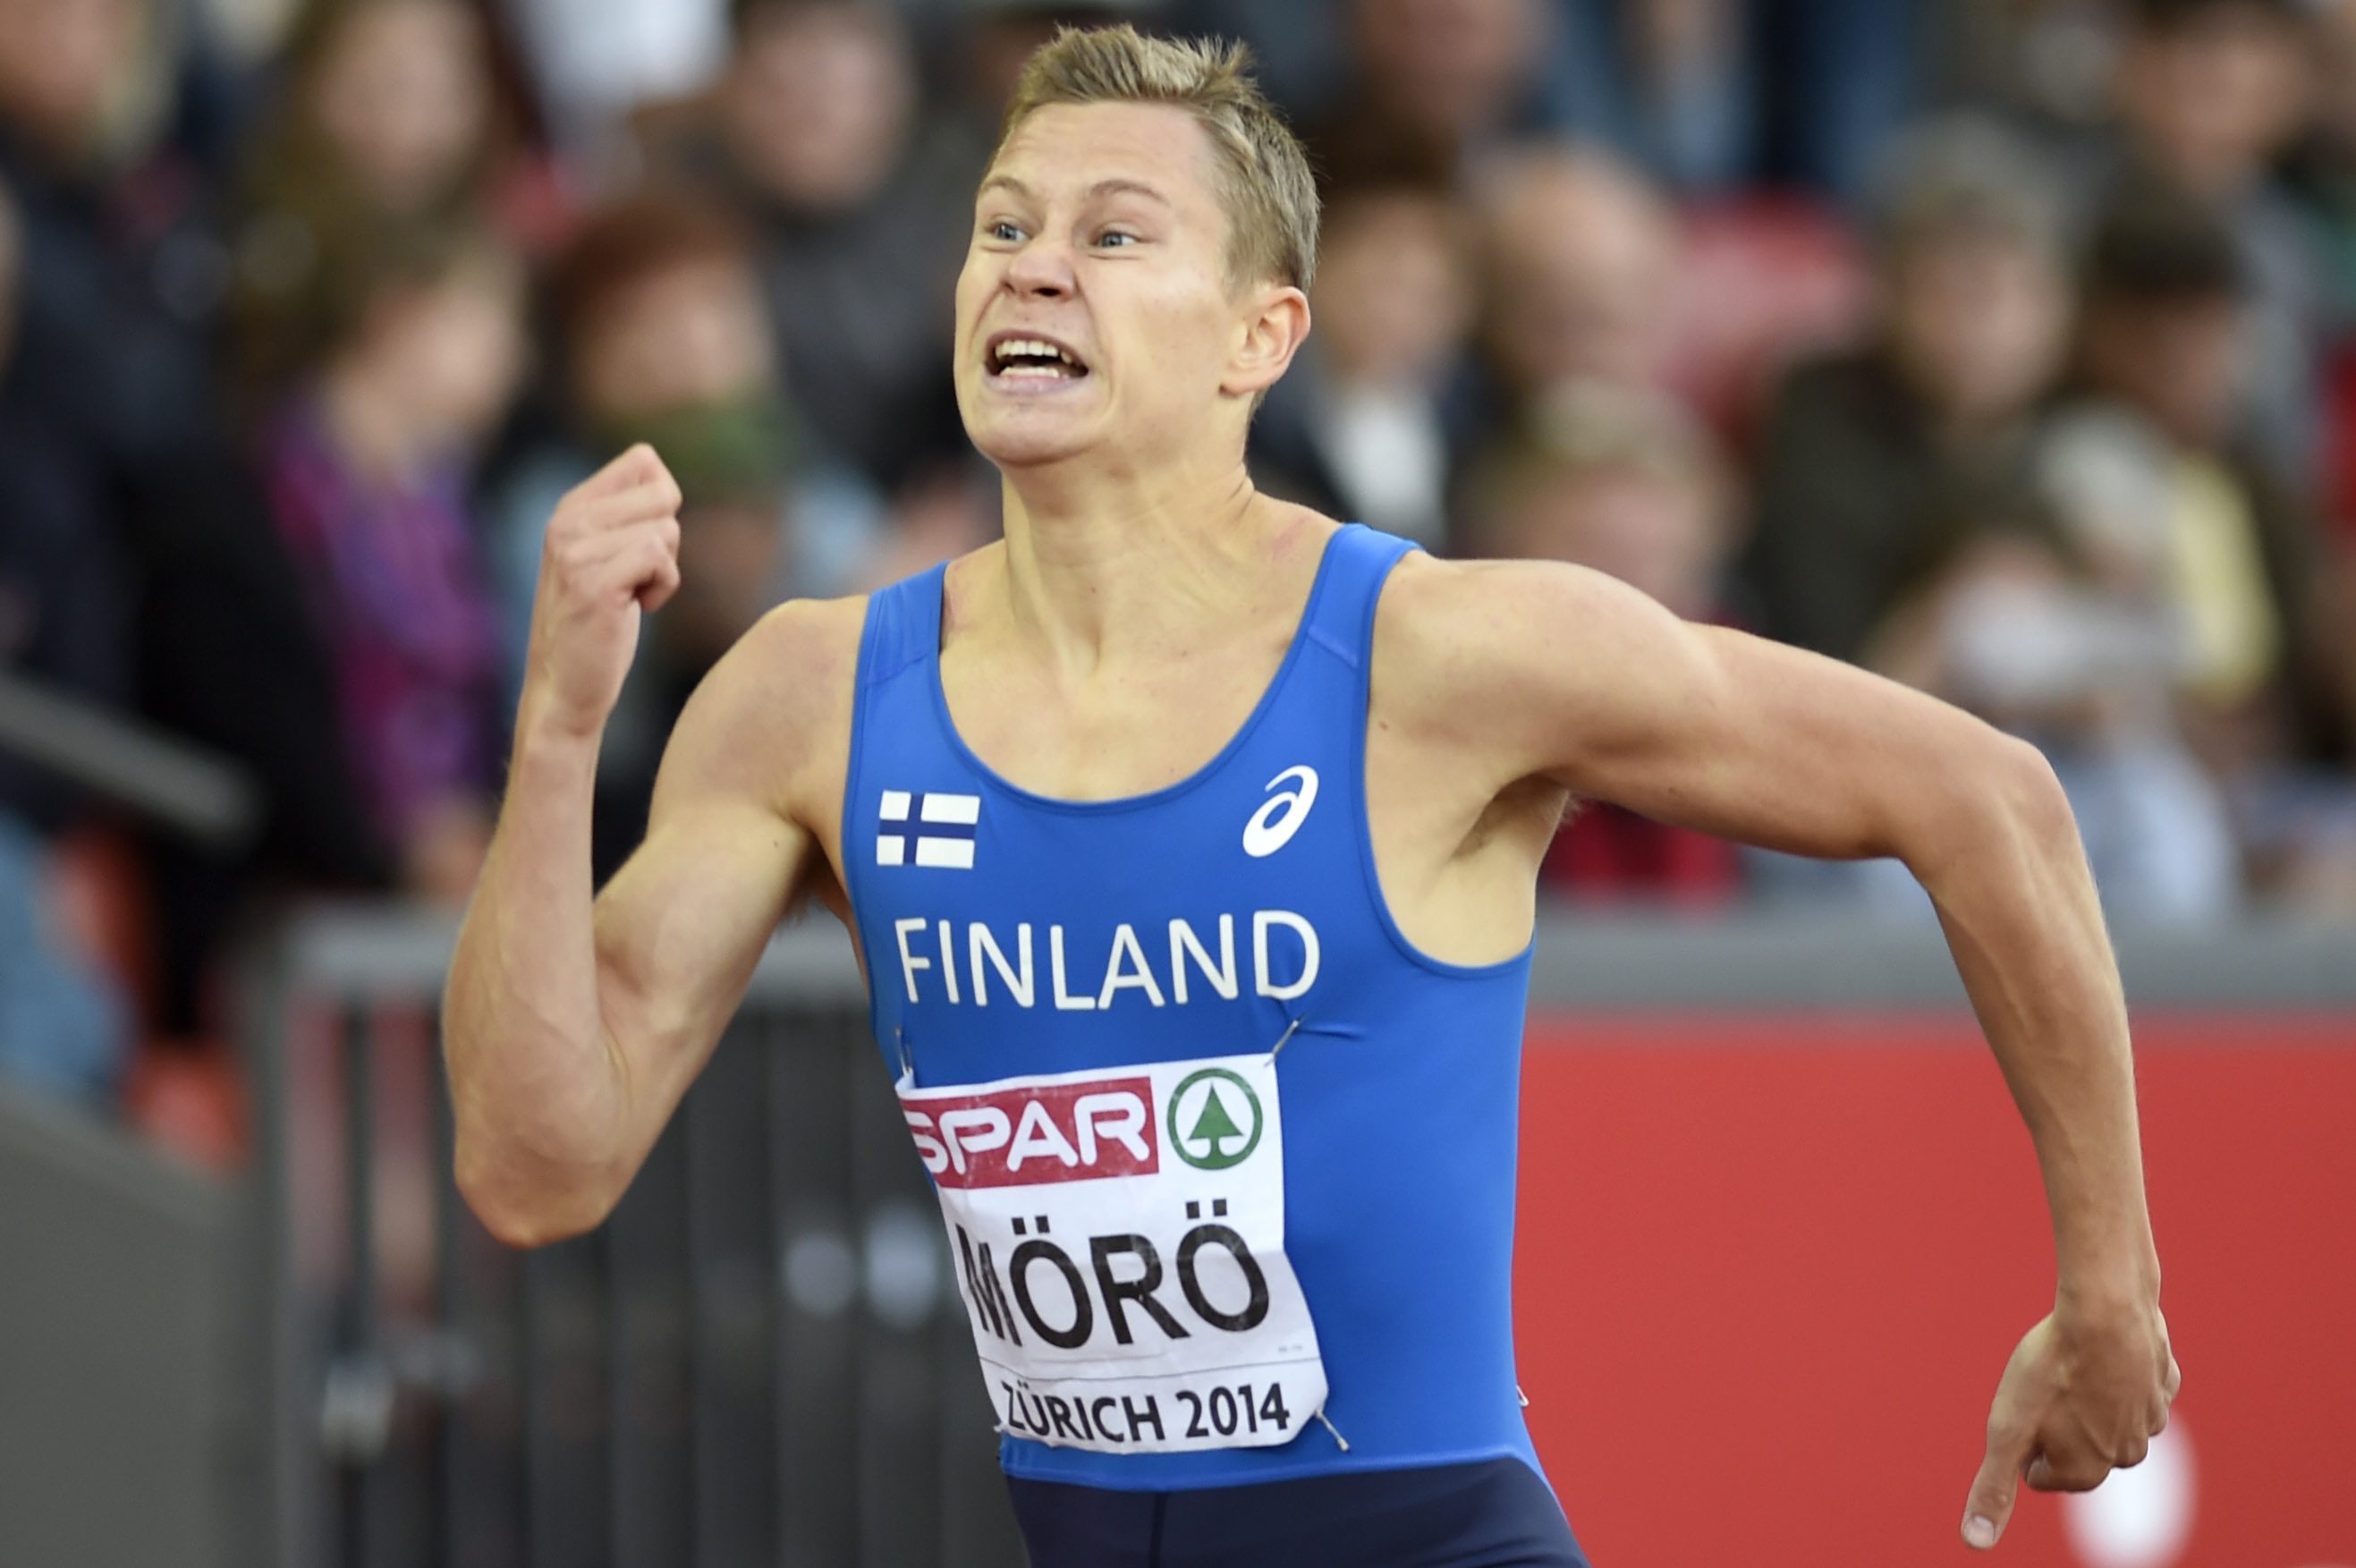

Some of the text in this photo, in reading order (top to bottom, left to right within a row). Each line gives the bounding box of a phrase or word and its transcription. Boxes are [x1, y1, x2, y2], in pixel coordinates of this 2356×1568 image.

[895, 911, 1319, 1009] FINLAND
[903, 1092, 1149, 1174] SPAR
[956, 1199, 1269, 1349] MÖRÖ
[1001, 1381, 1290, 1442] ZÜRICH 2014
